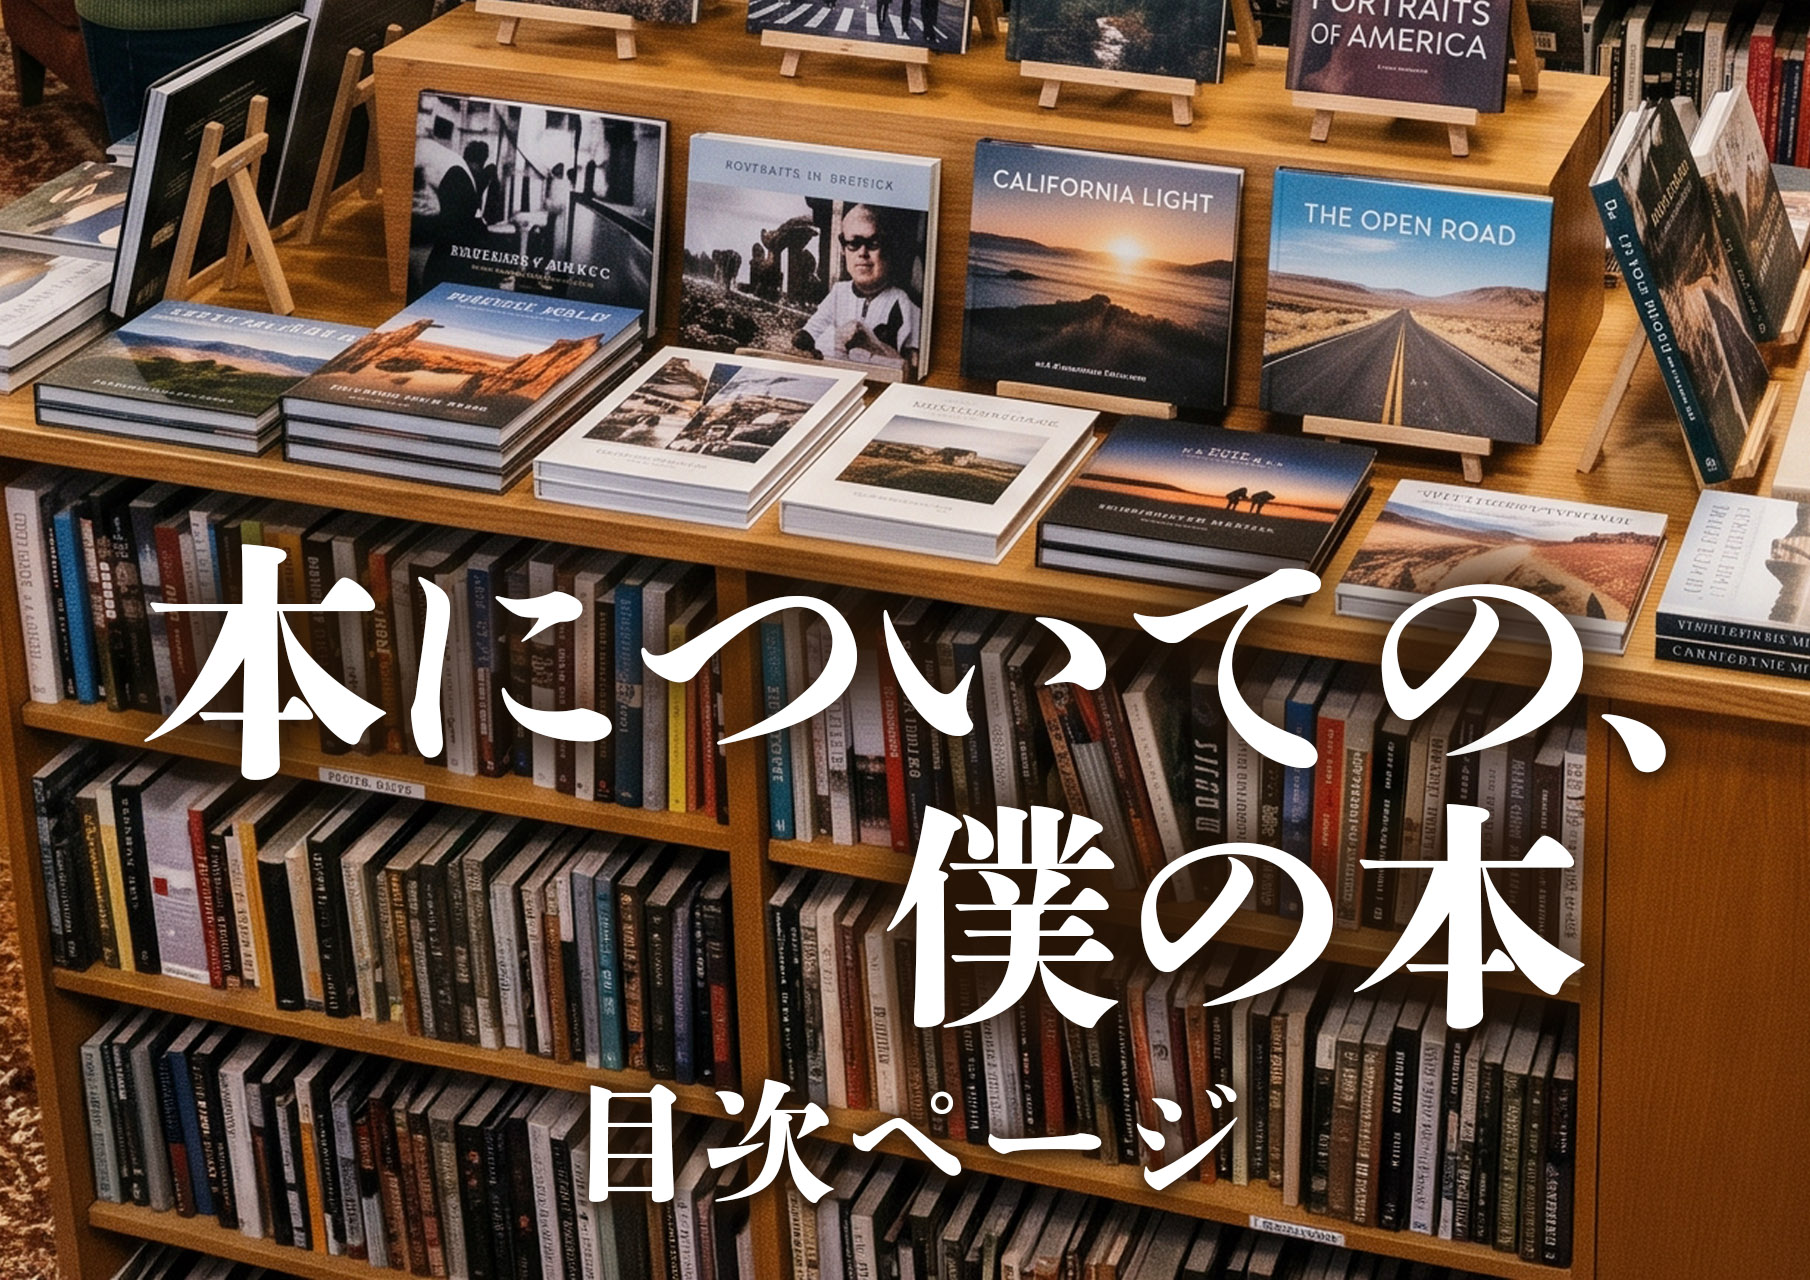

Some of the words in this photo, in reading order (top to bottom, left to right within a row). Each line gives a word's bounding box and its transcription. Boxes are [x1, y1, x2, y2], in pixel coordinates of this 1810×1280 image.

[1310, 22, 1342, 46] OF
[1346, 23, 1488, 60] AMERICA
[993, 169, 1136, 205] CALIFORNIA
[1142, 186, 1214, 214] LIGHT
[1304, 202, 1353, 228] THE
[1360, 209, 1432, 238] OPEN
[1440, 218, 1517, 247] ROAD
